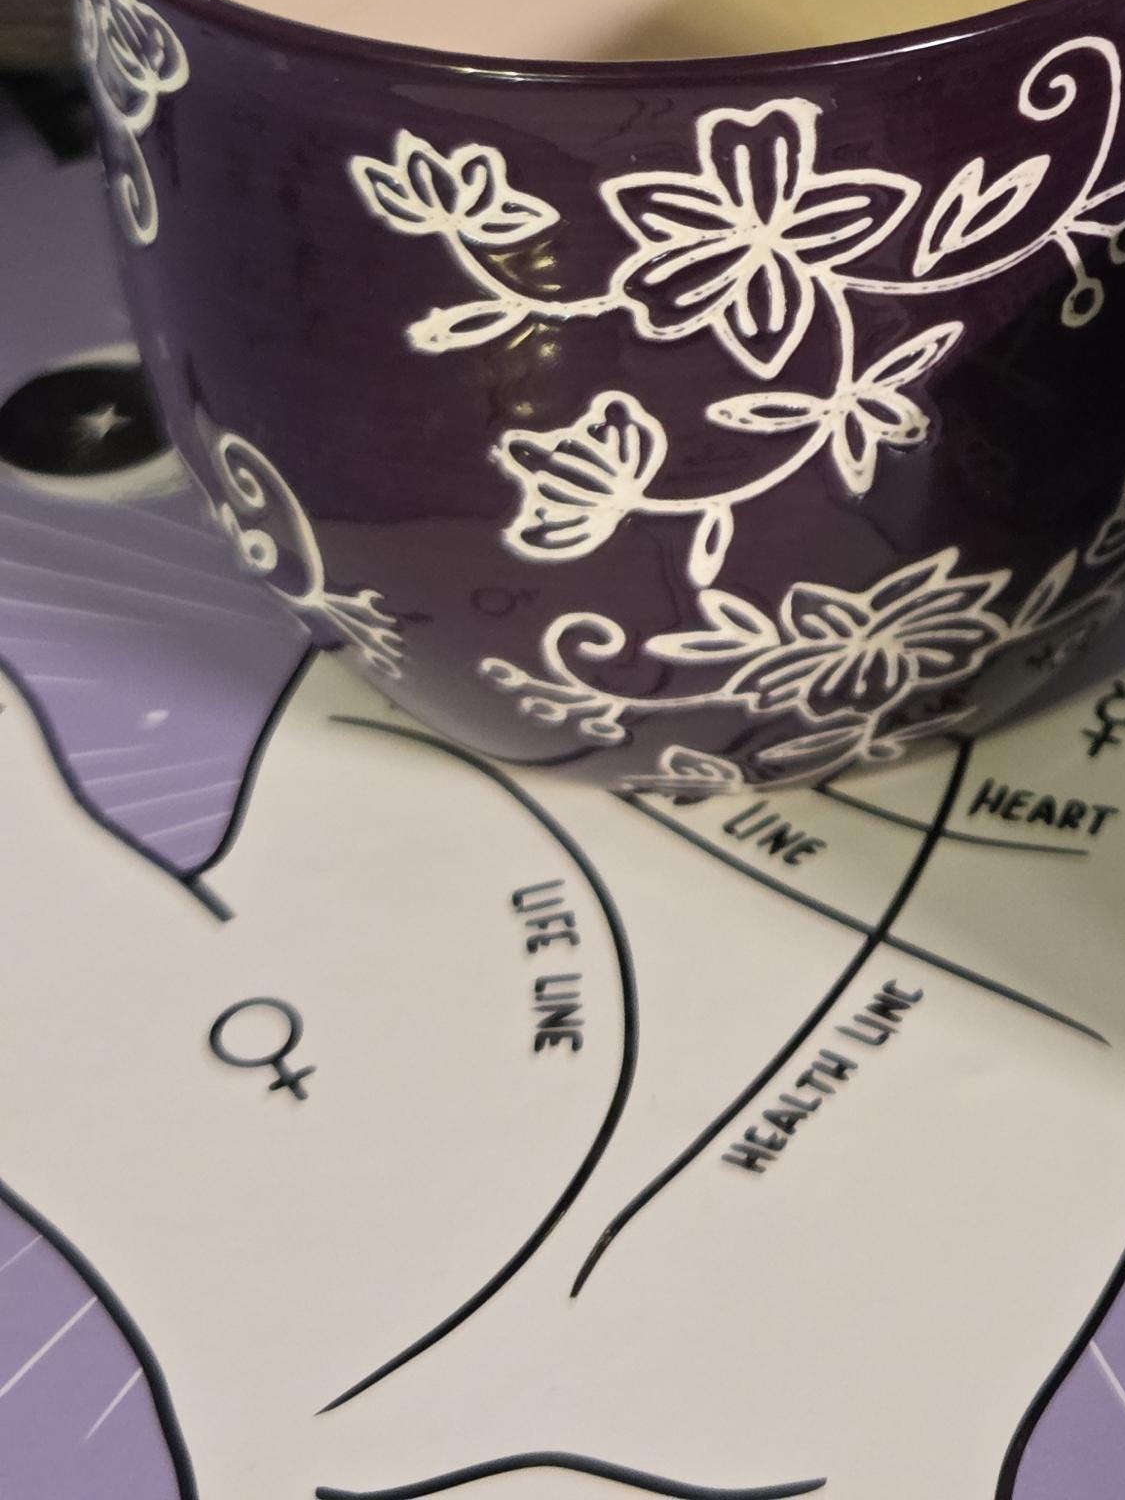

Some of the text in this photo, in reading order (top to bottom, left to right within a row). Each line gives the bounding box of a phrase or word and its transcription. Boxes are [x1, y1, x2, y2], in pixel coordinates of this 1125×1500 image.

[722, 799, 828, 865] LINE
[966, 777, 1120, 836] HEART
[511, 879, 585, 1053] LIFE LINE
[720, 1048, 859, 1174] HEALTH
